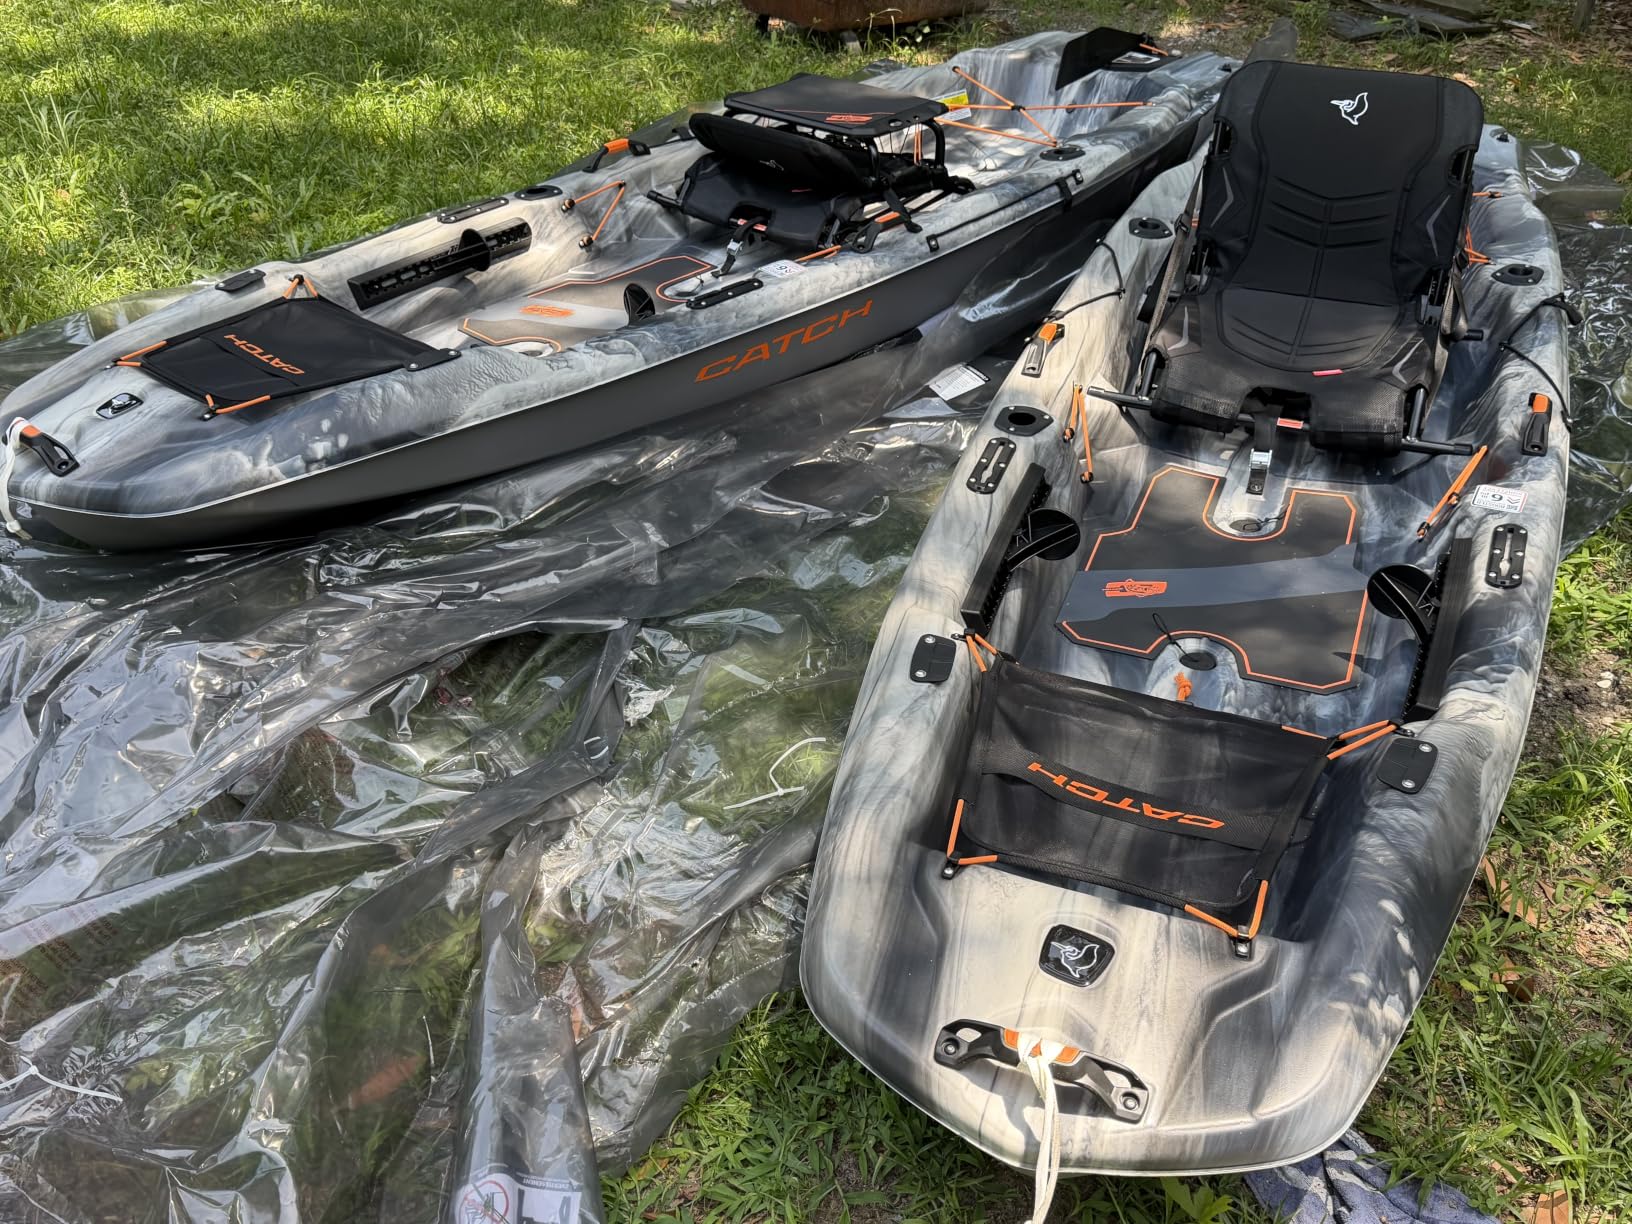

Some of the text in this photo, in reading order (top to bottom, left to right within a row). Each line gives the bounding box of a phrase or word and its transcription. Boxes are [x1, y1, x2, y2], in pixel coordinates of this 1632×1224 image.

[223, 334, 305, 375] CATCH
[695, 299, 873, 384] CATCH
[1027, 762, 1225, 829] CATCH
